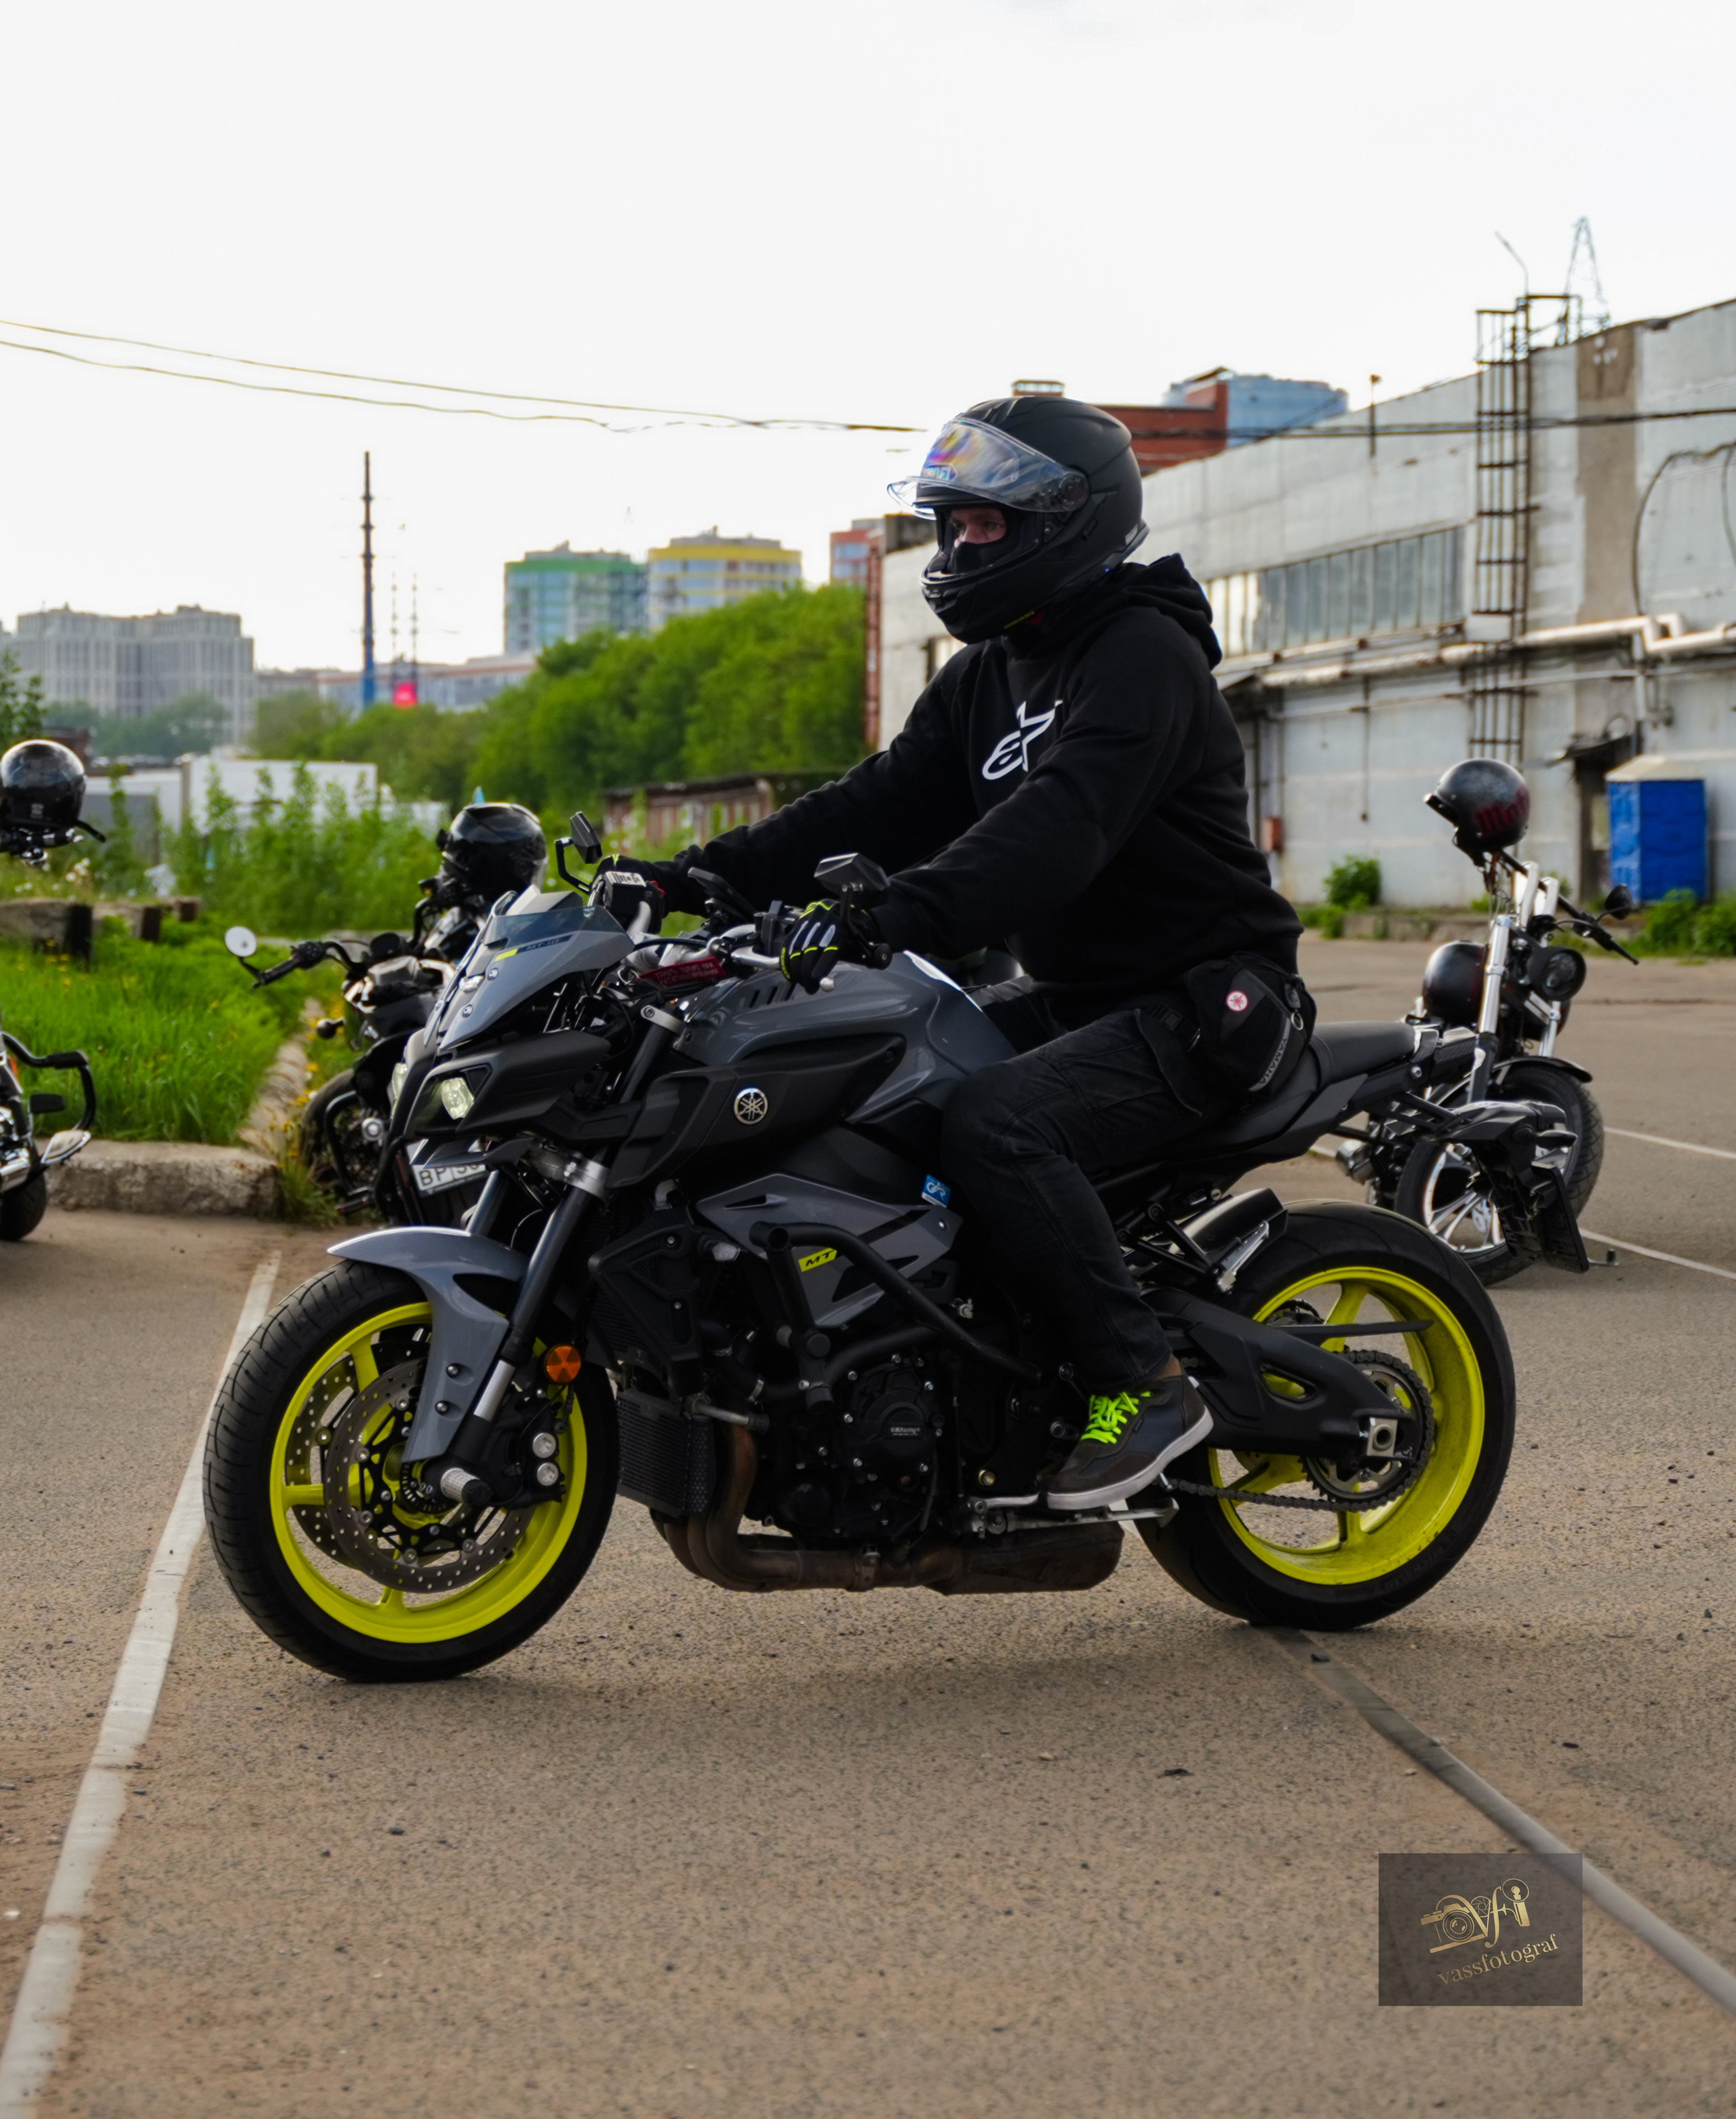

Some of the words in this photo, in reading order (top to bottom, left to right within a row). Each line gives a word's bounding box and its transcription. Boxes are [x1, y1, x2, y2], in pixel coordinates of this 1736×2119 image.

[526, 938, 560, 951] MT-10
[1259, 1038, 1288, 1084] YAMAHA
[805, 1250, 834, 1267] MT
